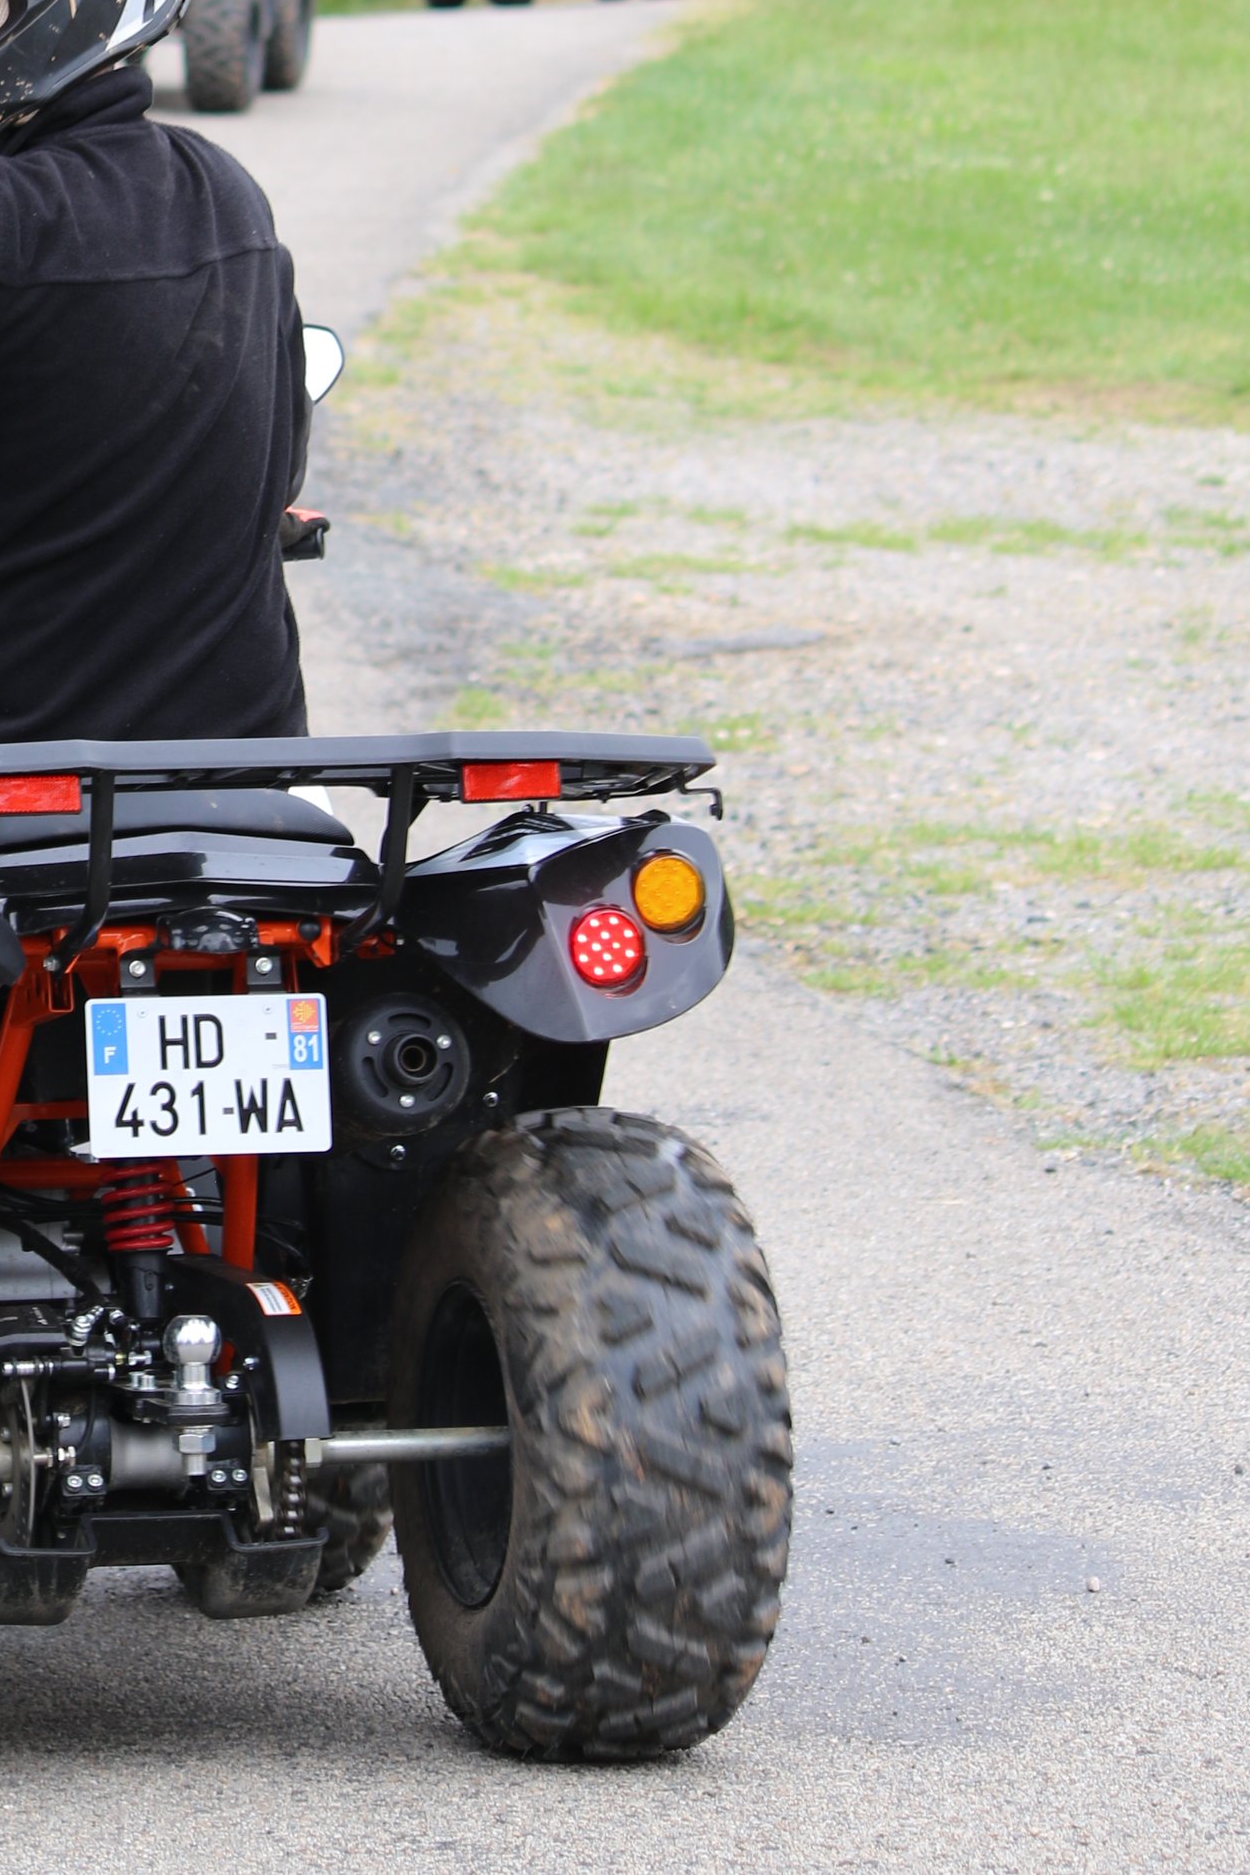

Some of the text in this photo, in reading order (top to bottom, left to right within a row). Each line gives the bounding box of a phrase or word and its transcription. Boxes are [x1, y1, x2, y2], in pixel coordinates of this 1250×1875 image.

[104, 1046, 116, 1063] F
[158, 1014, 224, 1069] HD
[293, 1034, 319, 1062] 81
[114, 1077, 304, 1138] 431-WA
